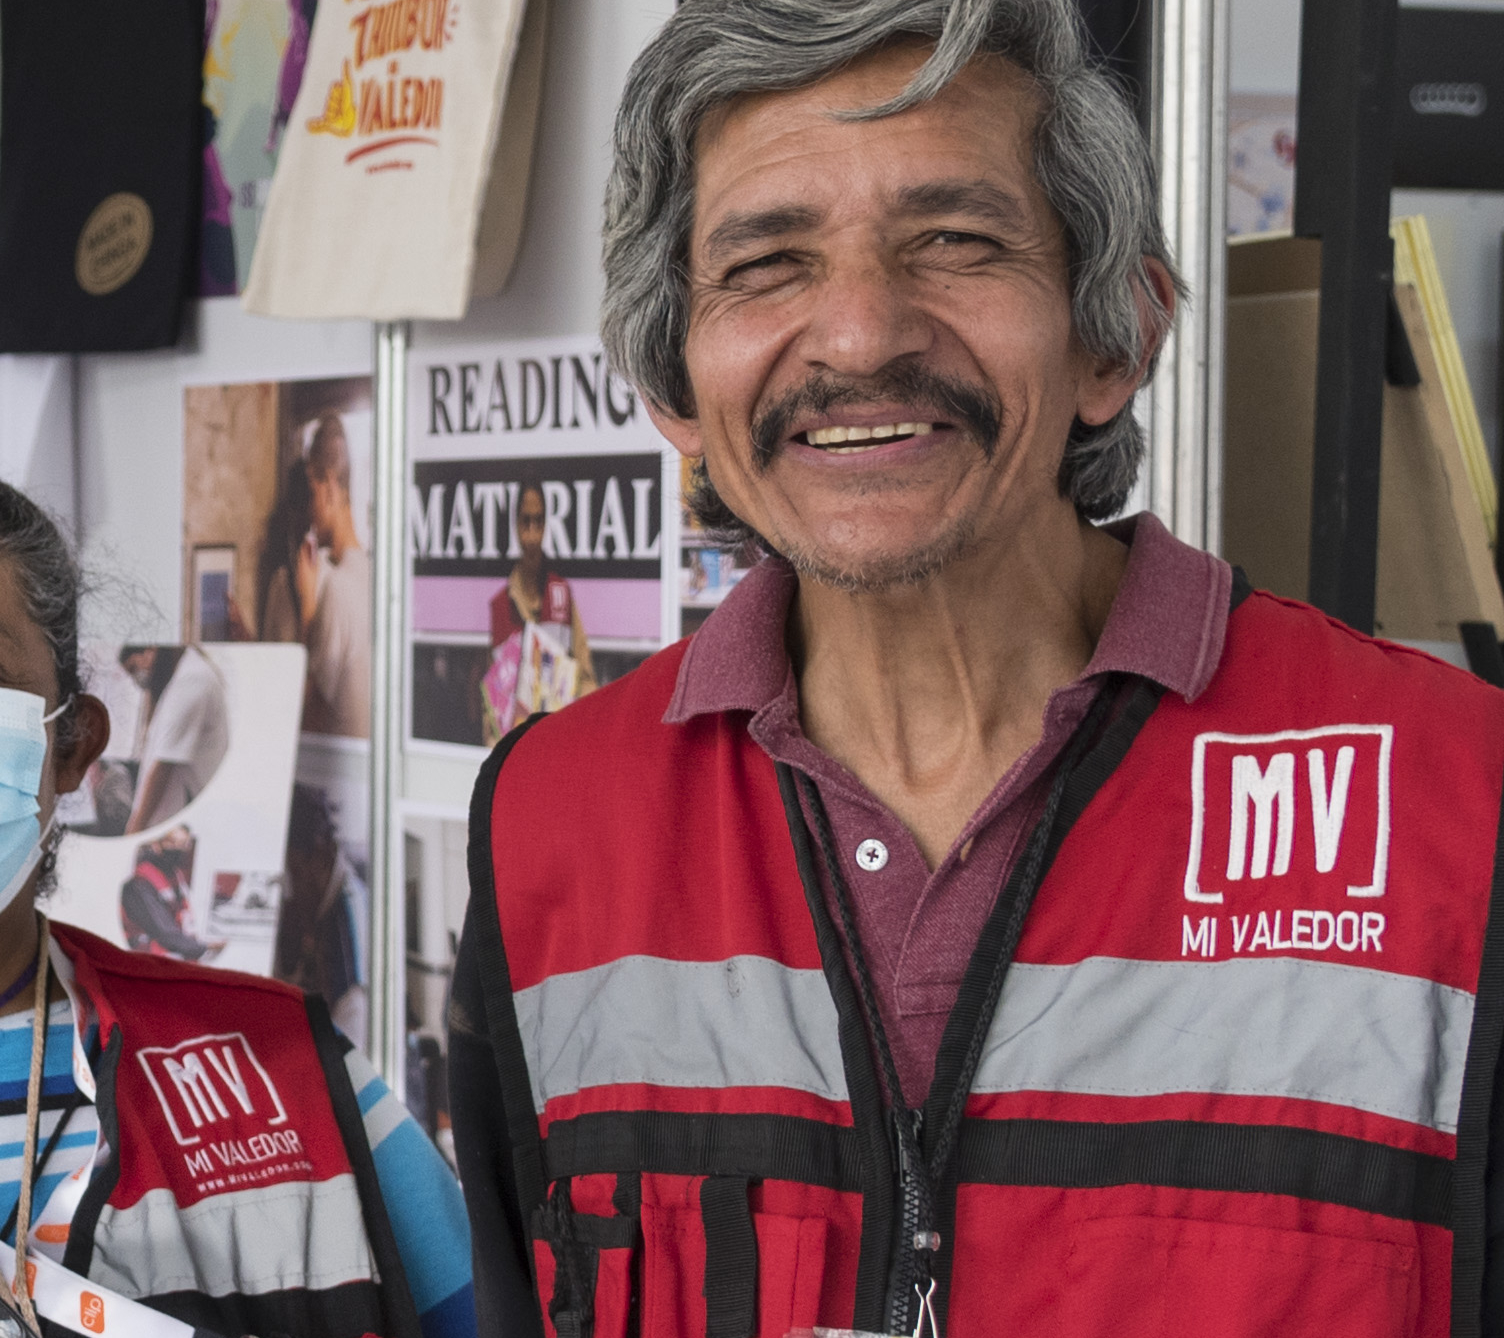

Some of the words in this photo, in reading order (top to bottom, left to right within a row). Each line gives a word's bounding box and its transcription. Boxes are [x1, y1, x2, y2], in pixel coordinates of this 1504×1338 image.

[357, 77, 443, 137] VALEDOR
[427, 351, 636, 437] READING
[1226, 745, 1355, 881] MV
[1181, 914, 1217, 957] MI
[1231, 910, 1386, 953] VALEDOR
[162, 1045, 255, 1128] MV
[183, 1149, 215, 1178] MI
[209, 1128, 304, 1167] VALEDOR
[83, 1296, 103, 1328] clip
